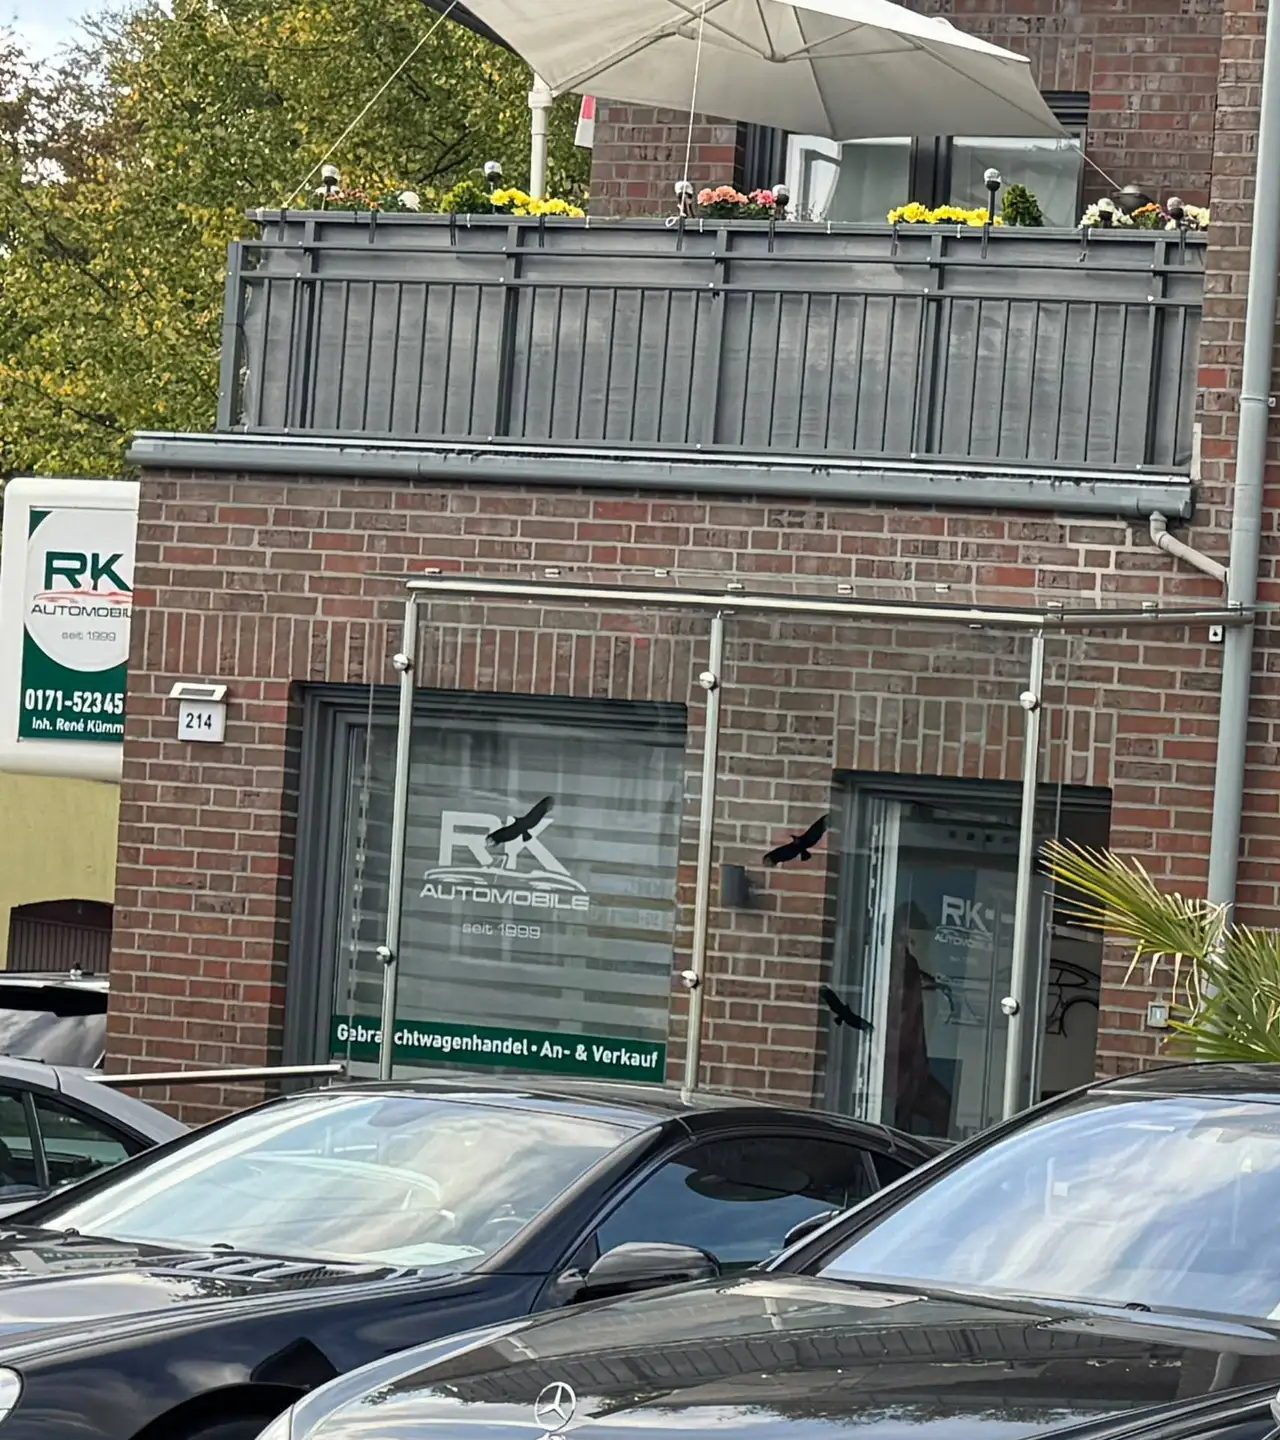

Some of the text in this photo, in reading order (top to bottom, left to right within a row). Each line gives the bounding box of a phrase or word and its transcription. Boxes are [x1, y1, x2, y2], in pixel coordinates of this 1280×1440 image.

[44, 551, 133, 592] RK
[31, 604, 131, 618] AUTOMOBIL
[86, 631, 116, 641] 1999
[25, 688, 124, 714] 0171-52345
[32, 716, 53, 730] Inh.
[56, 717, 85, 732] René
[186, 712, 212, 730] 214
[439, 811, 571, 877] RK
[420, 884, 589, 910] AUTOMOBILE
[941, 895, 989, 933] RK
[462, 923, 541, 939] seit 1999
[337, 1023, 658, 1069] Gebrachtwagenhandel An- & Verkauf
